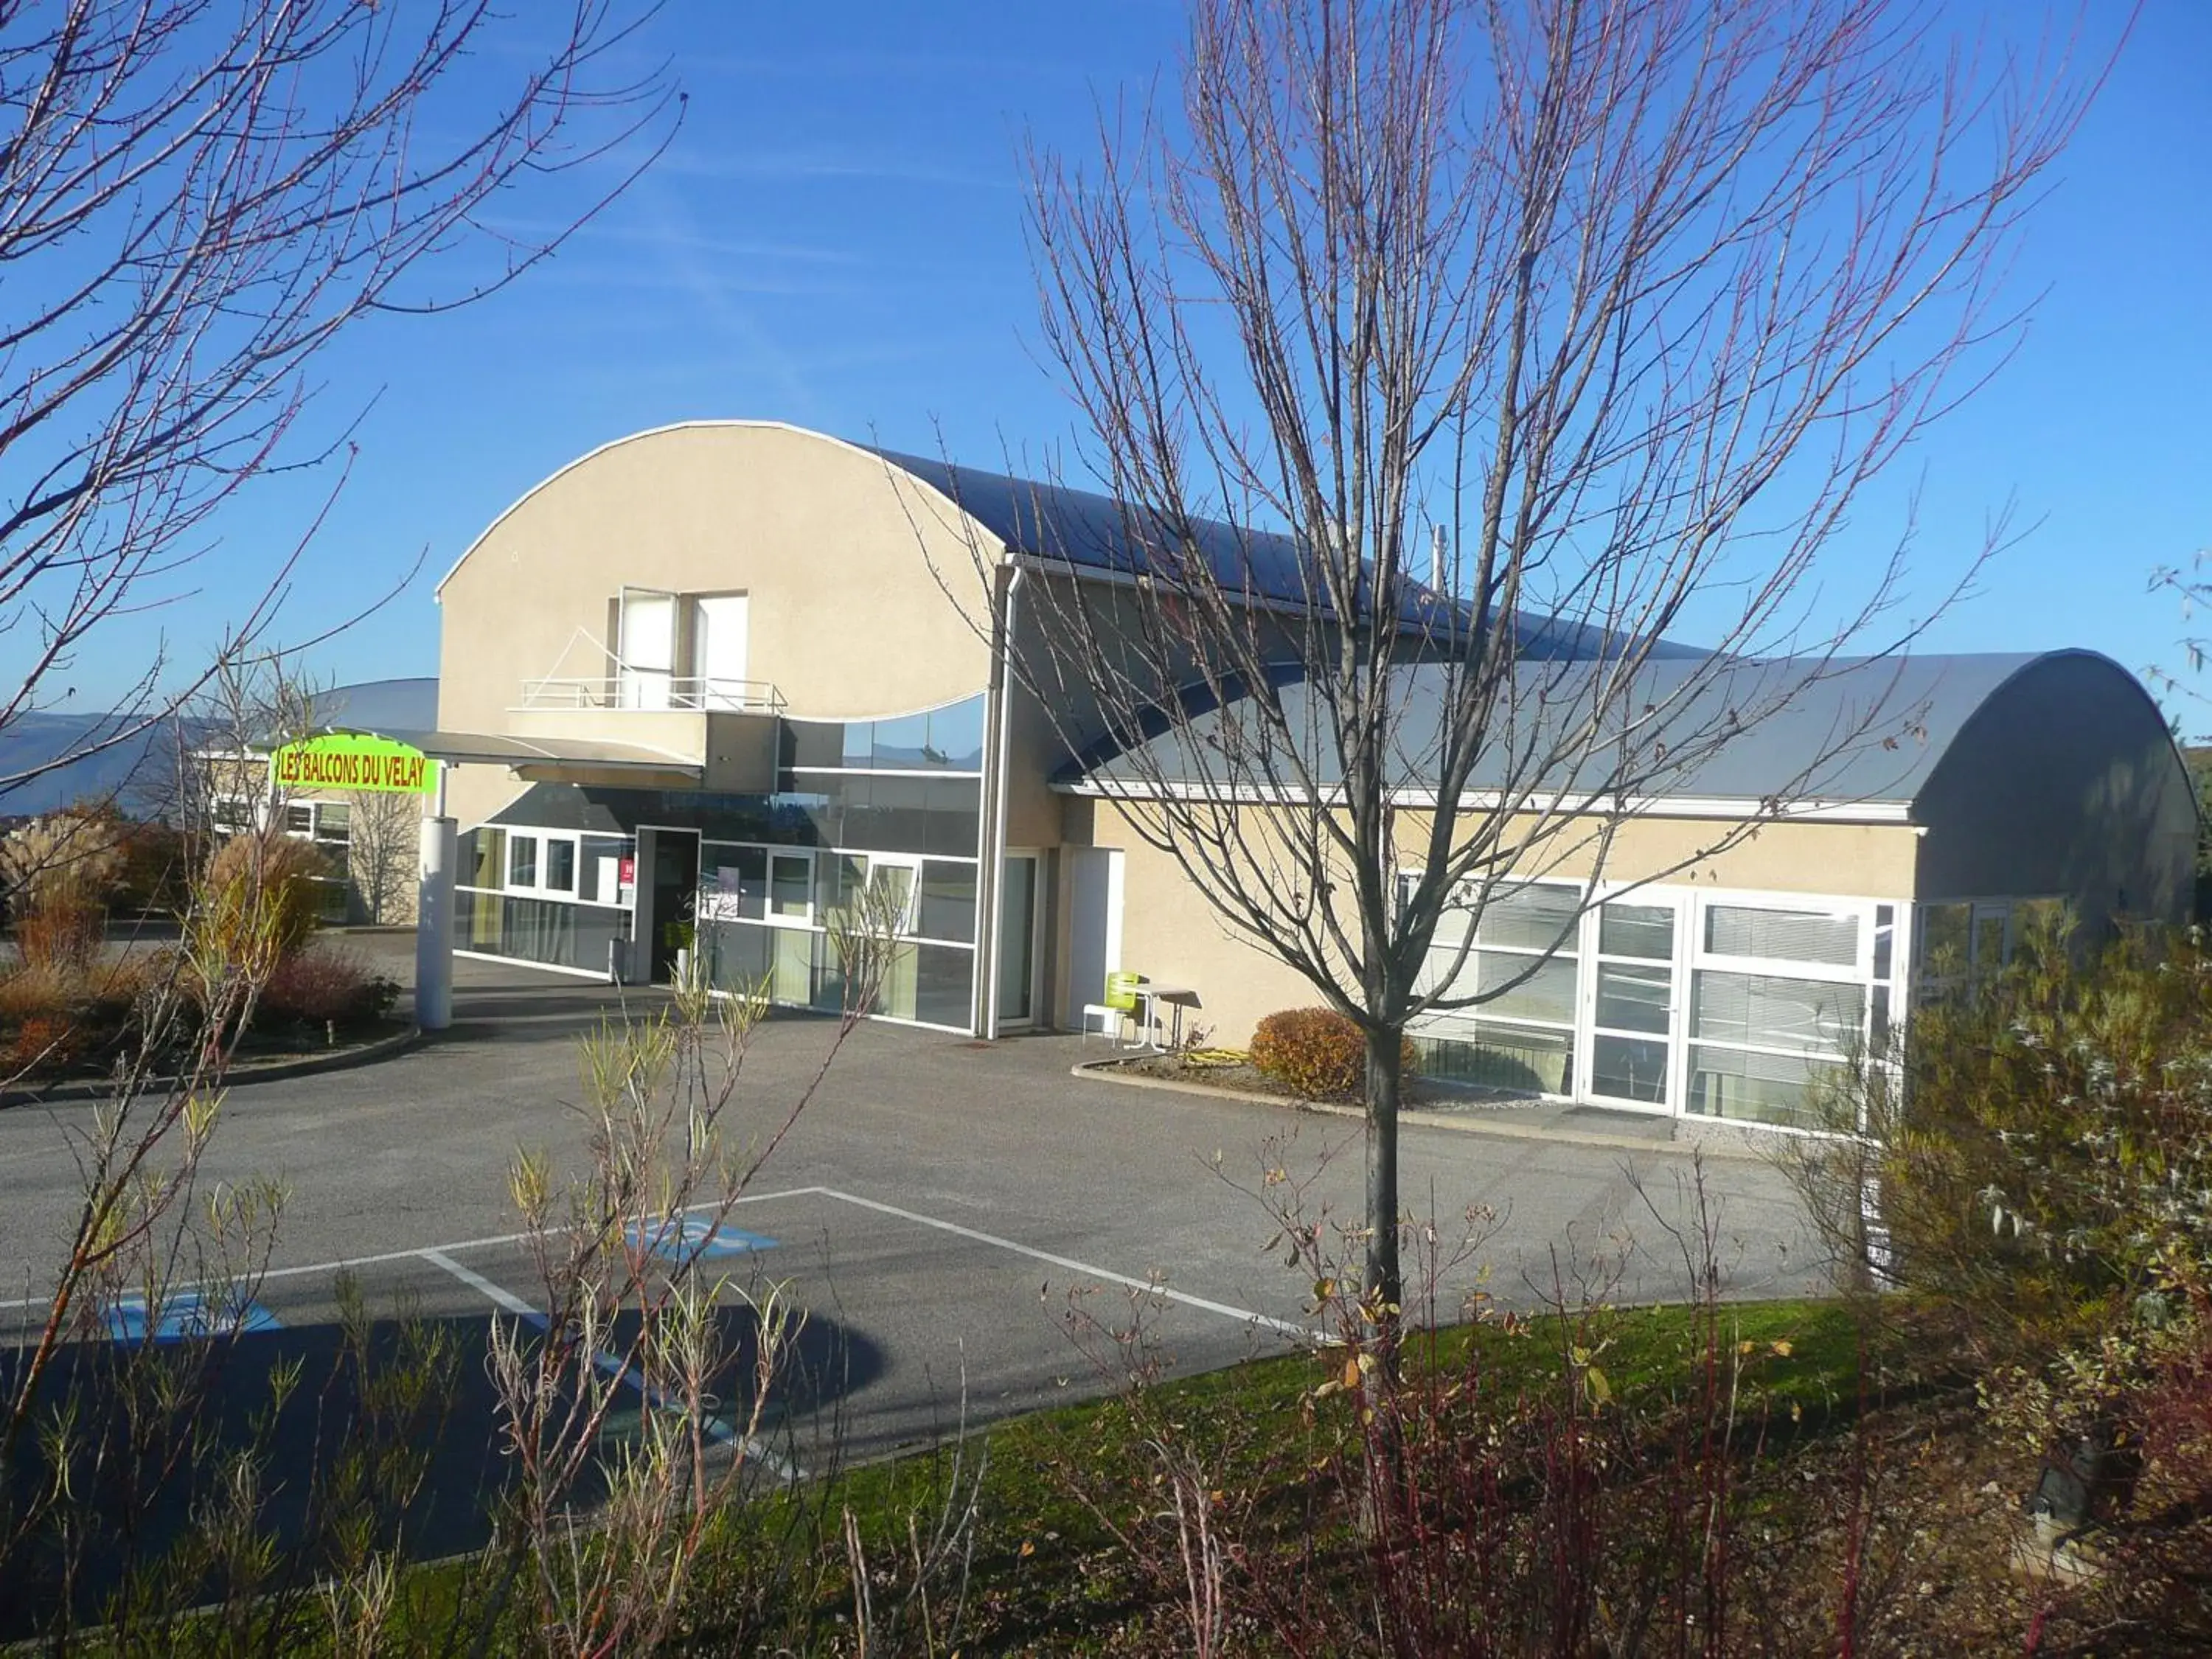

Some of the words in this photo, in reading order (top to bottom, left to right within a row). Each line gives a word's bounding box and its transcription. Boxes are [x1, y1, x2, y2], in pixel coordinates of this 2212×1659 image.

[280, 752, 299, 779] LES
[303, 754, 358, 784] BALCONS
[362, 756, 380, 784] DU
[385, 757, 425, 787] VELAY
